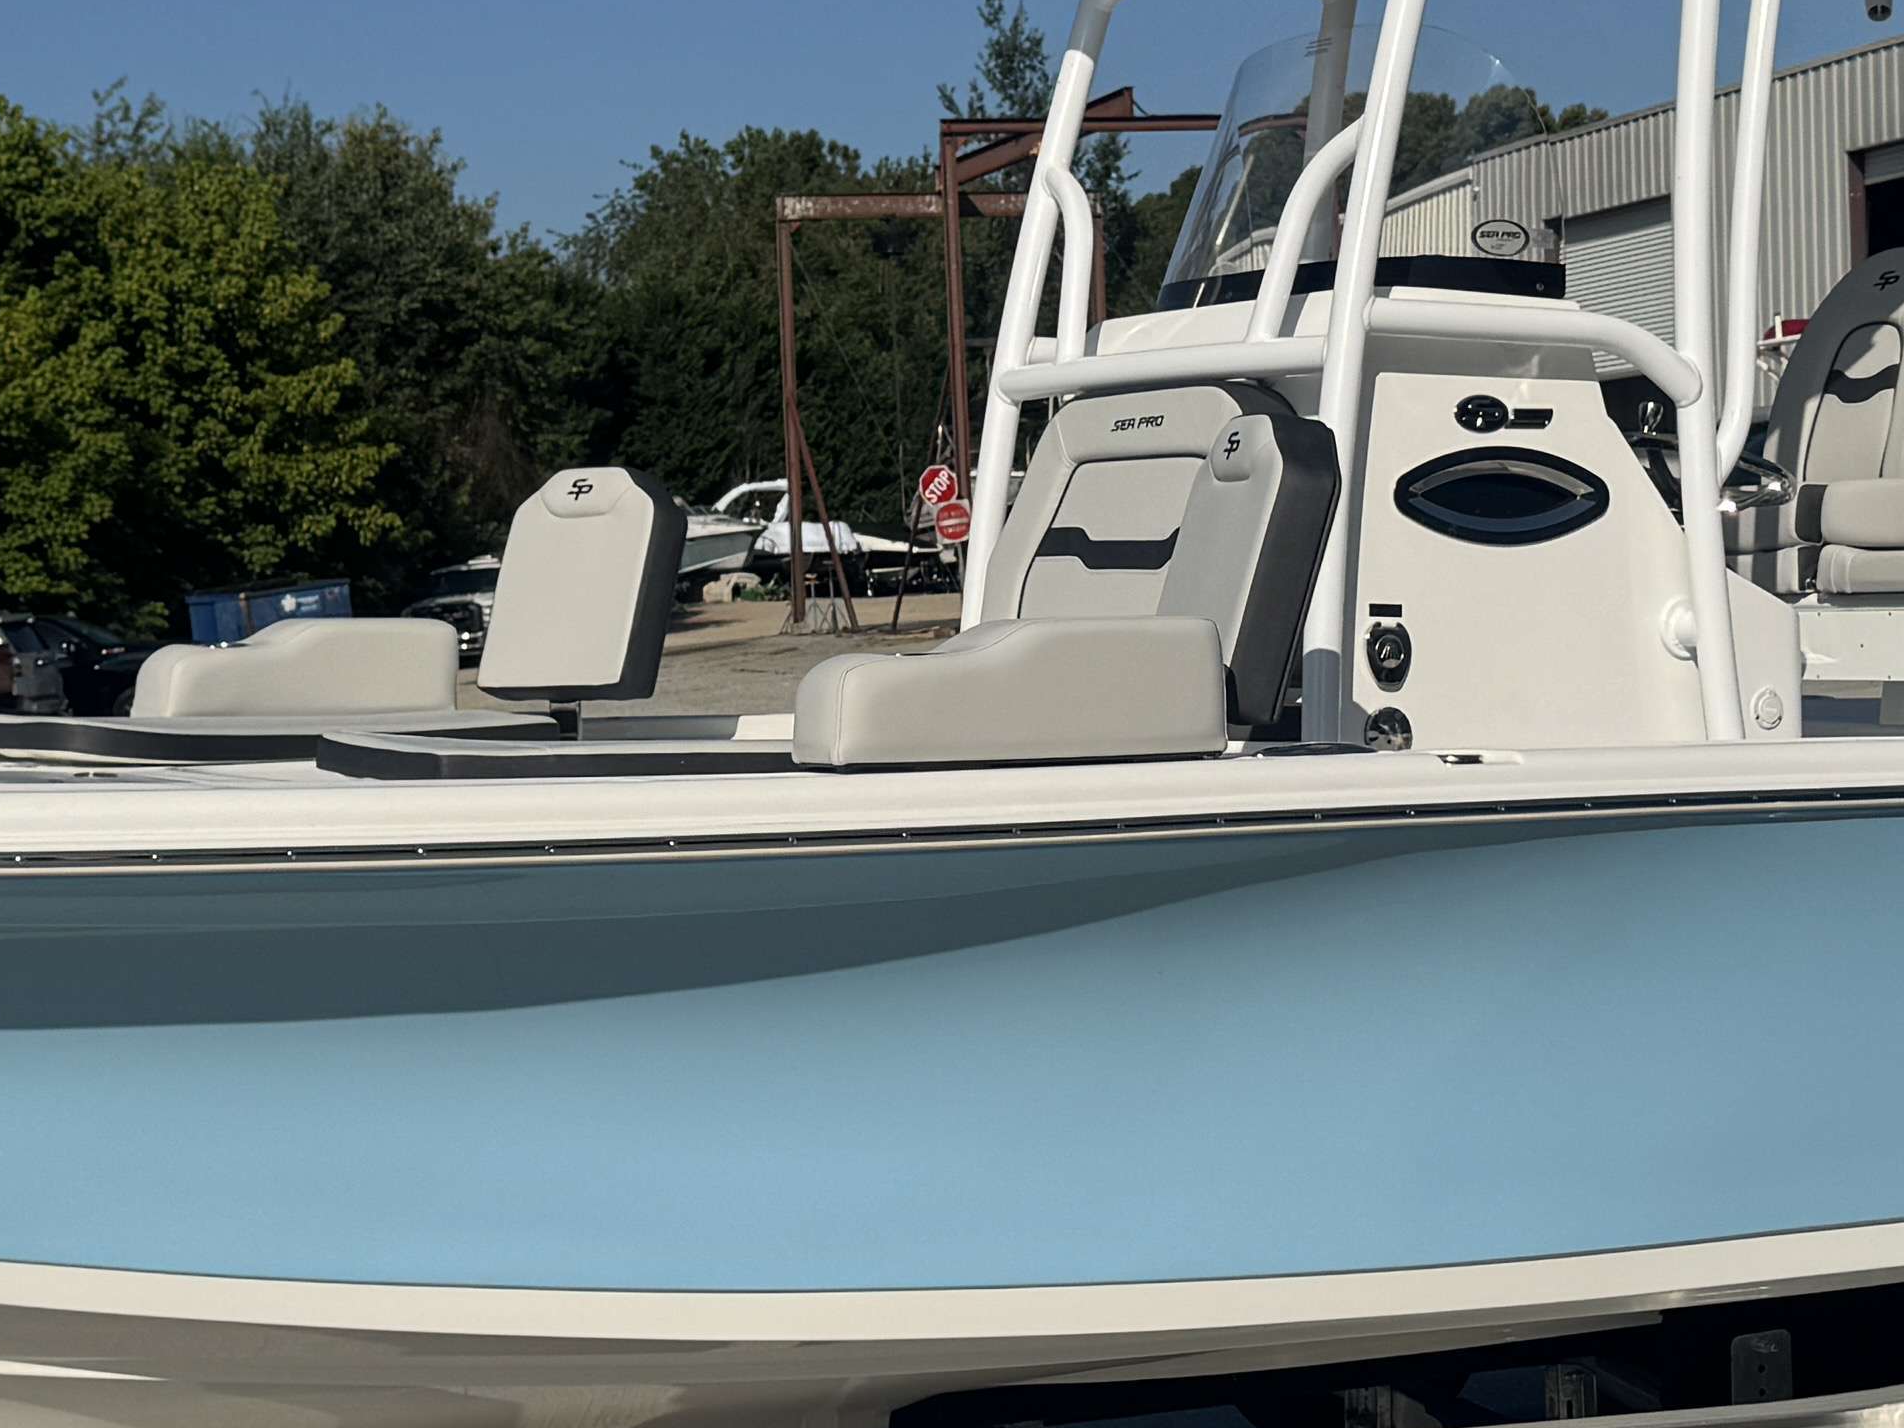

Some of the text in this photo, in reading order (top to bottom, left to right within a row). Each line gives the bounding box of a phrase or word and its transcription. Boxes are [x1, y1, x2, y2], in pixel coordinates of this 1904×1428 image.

[1110, 415, 1165, 432] SEA PRO
[924, 470, 951, 504] STOP
